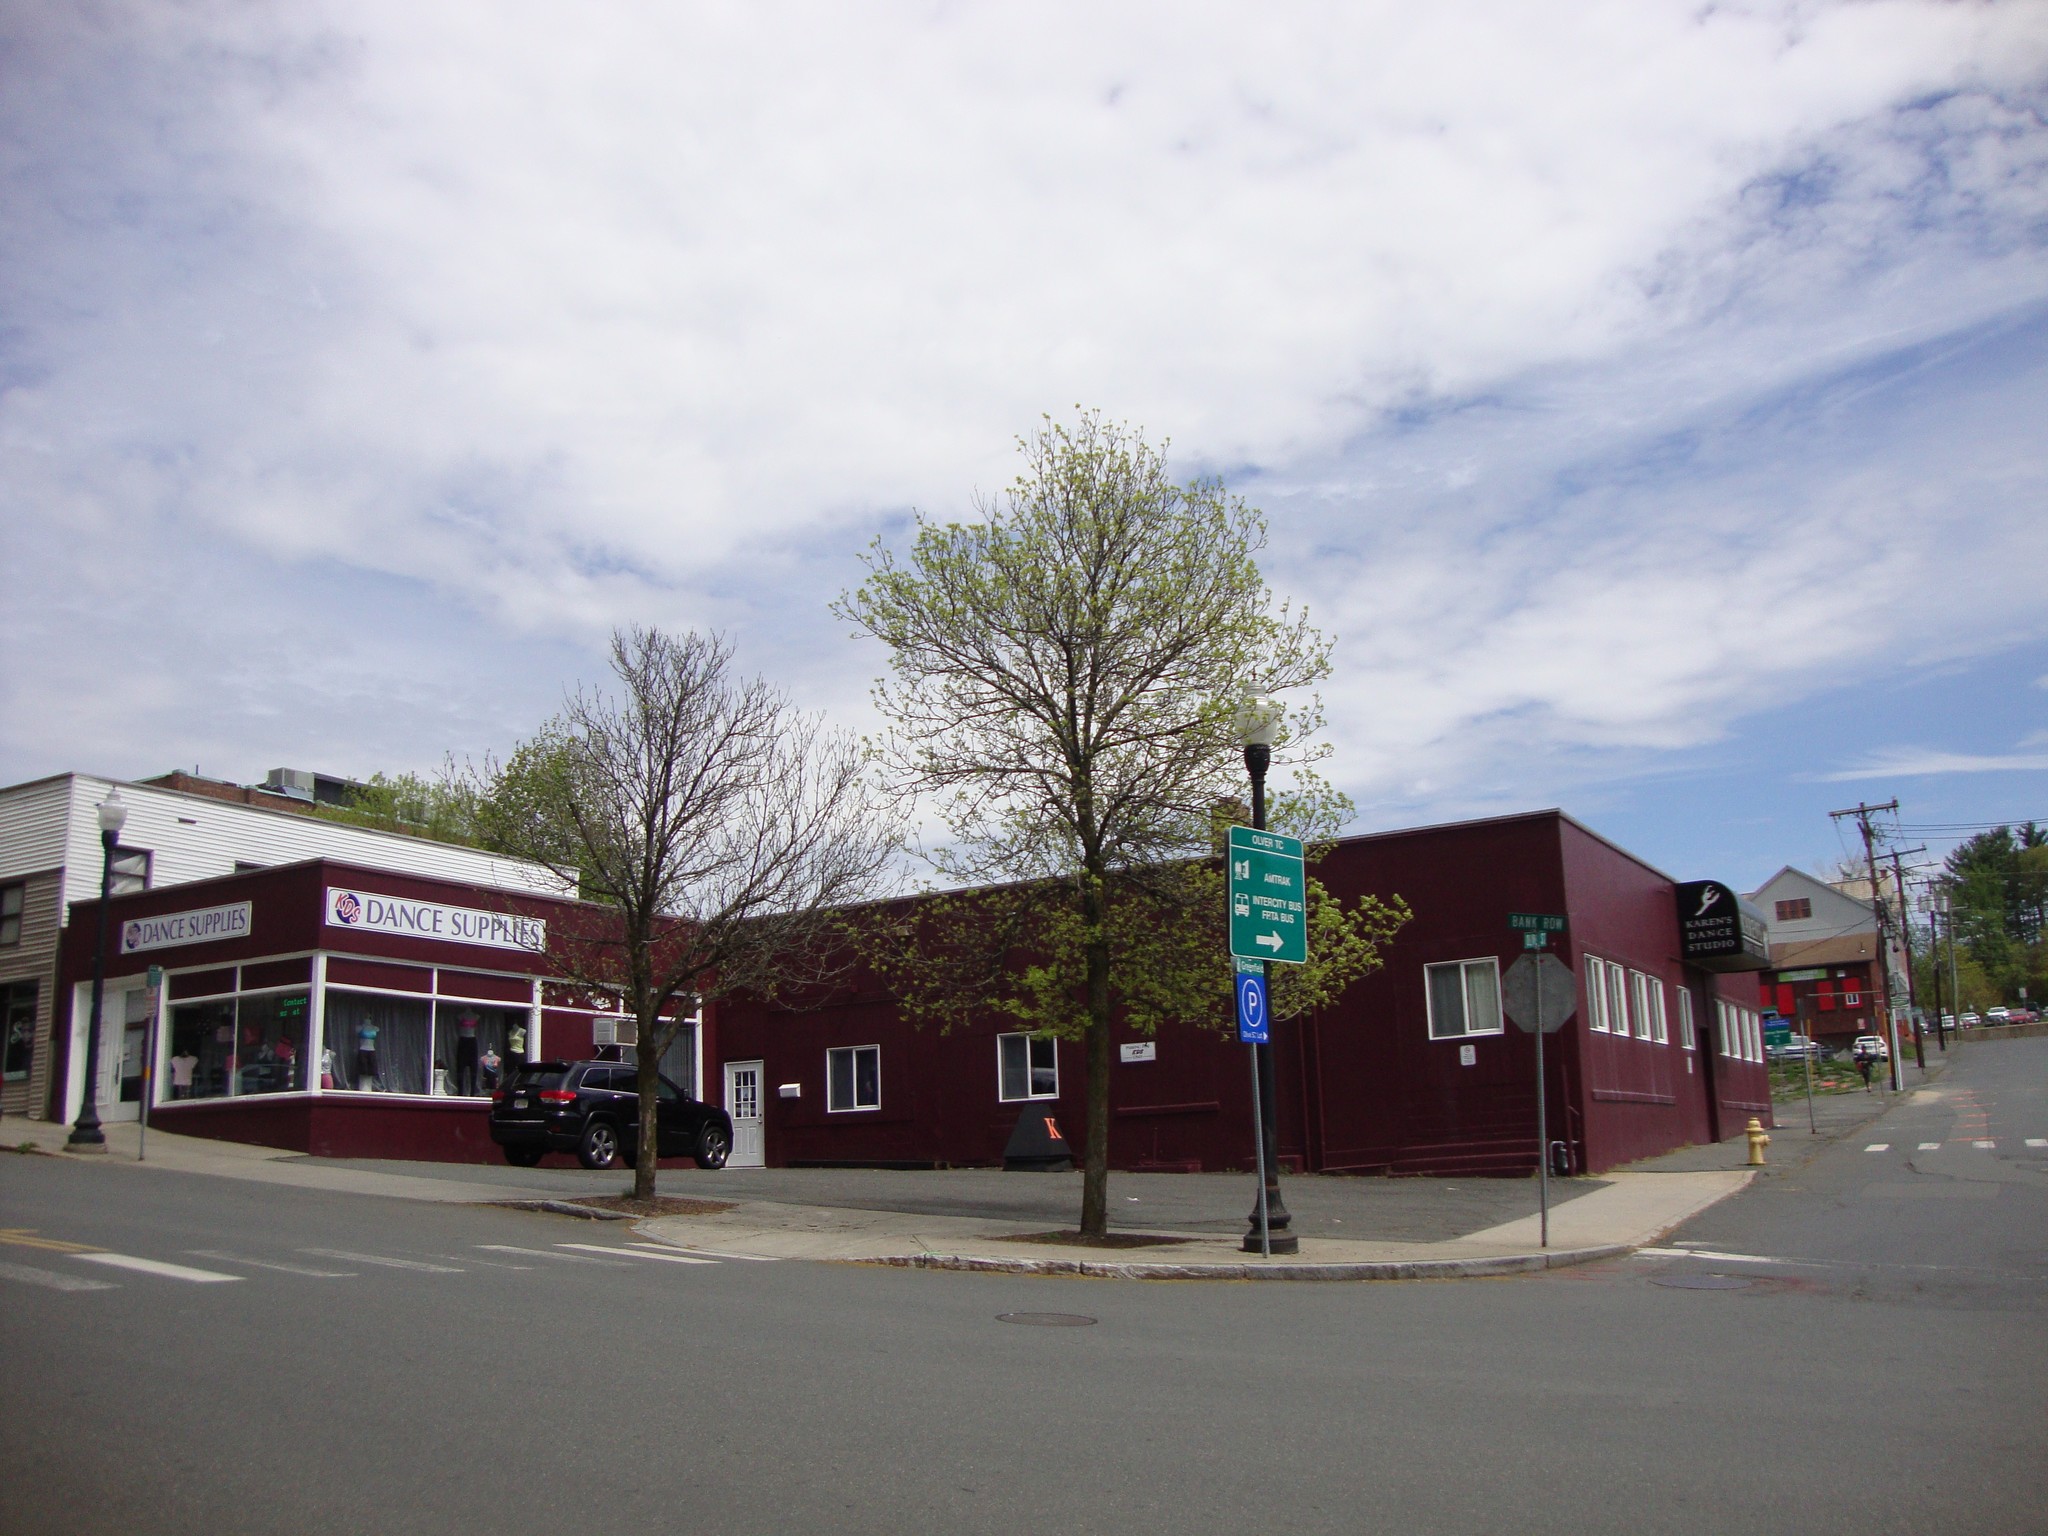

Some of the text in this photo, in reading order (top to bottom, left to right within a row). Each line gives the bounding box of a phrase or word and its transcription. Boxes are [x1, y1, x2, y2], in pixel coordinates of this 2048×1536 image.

[1252, 835, 1285, 850] OLVER TC
[1264, 873, 1292, 887] AMTRAK
[334, 892, 361, 923] KDS
[1252, 895, 1303, 912] INTERCITY BUS
[143, 919, 185, 944] DANCE
[189, 908, 246, 937] SUPPLIES
[366, 899, 541, 945] DANCE SUPPLIES
[1280, 913, 1295, 924] BUS
[1512, 915, 1563, 930] BANK ROW
[1686, 916, 1733, 928] KAREN'S
[1688, 928, 1733, 940] DANCE
[1688, 940, 1735, 952] STUDIO
[1248, 991, 1258, 1015] P
[1043, 1117, 1063, 1139] K
